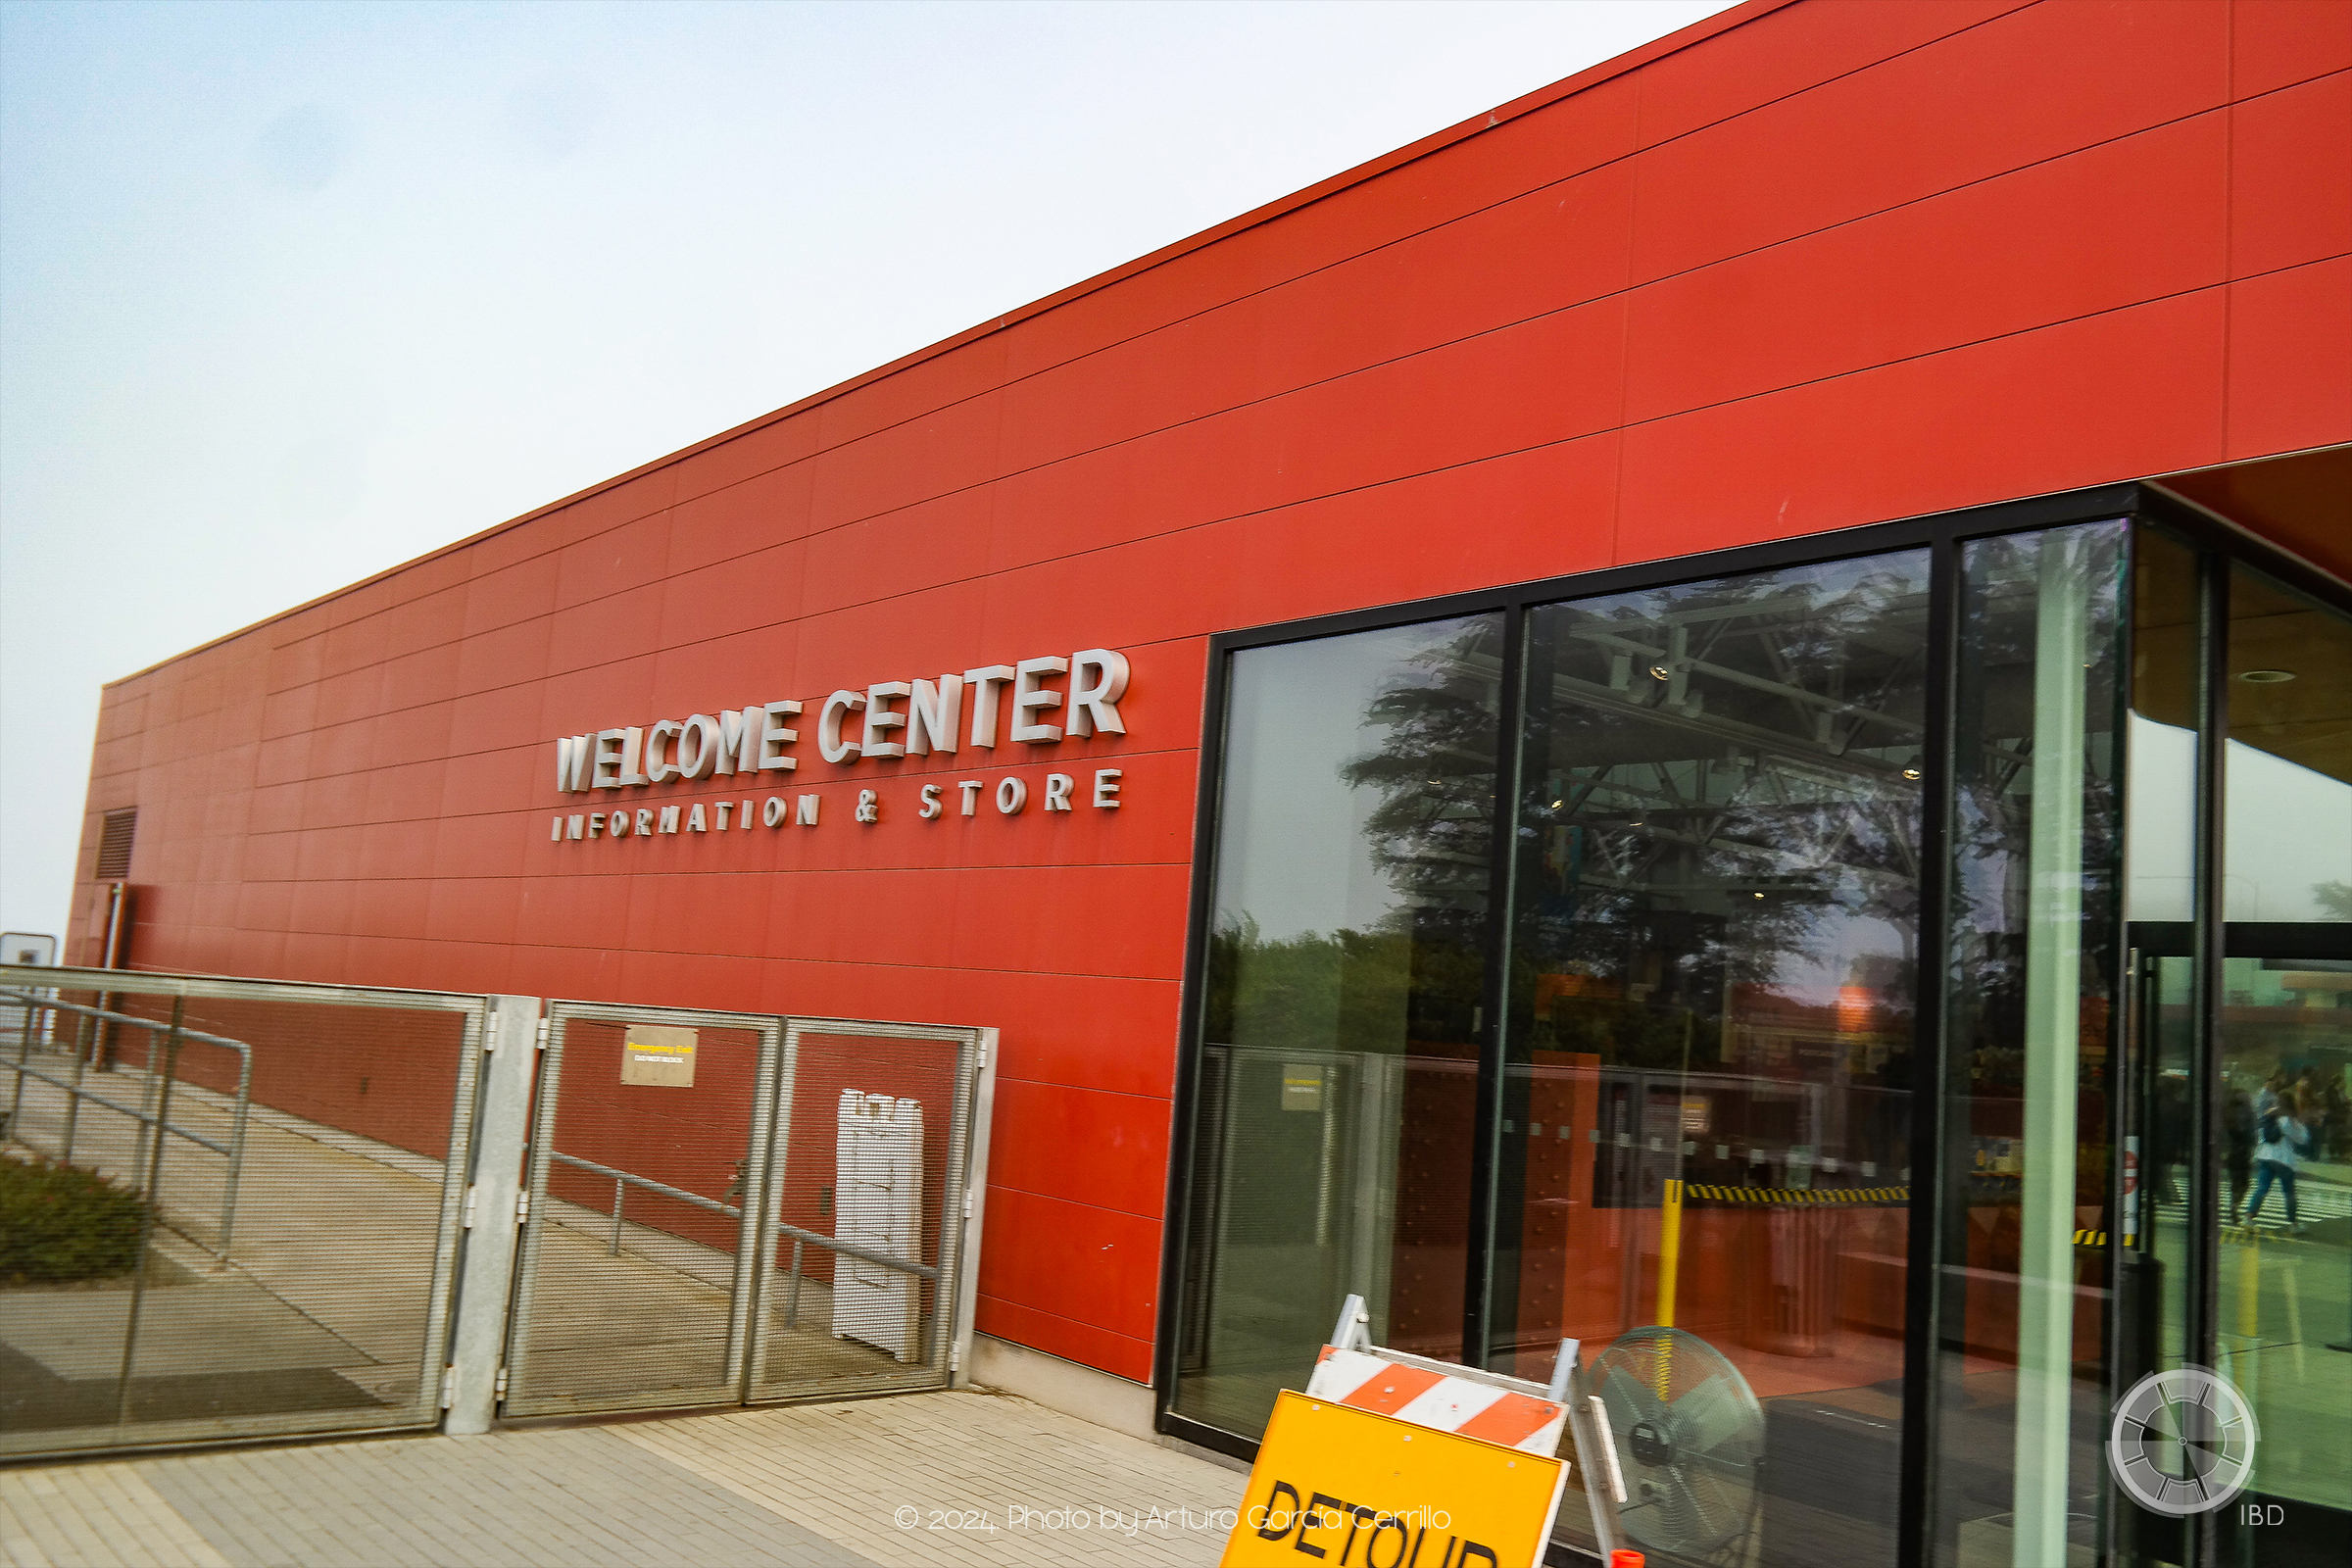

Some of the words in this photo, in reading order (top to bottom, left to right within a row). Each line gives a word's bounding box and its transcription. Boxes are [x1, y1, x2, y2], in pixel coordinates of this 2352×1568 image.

[556, 700, 804, 793] WELCOME
[817, 648, 1131, 765] CENTER
[551, 793, 820, 843] INFORMATION
[855, 789, 878, 823] &
[918, 768, 1124, 819] STORE
